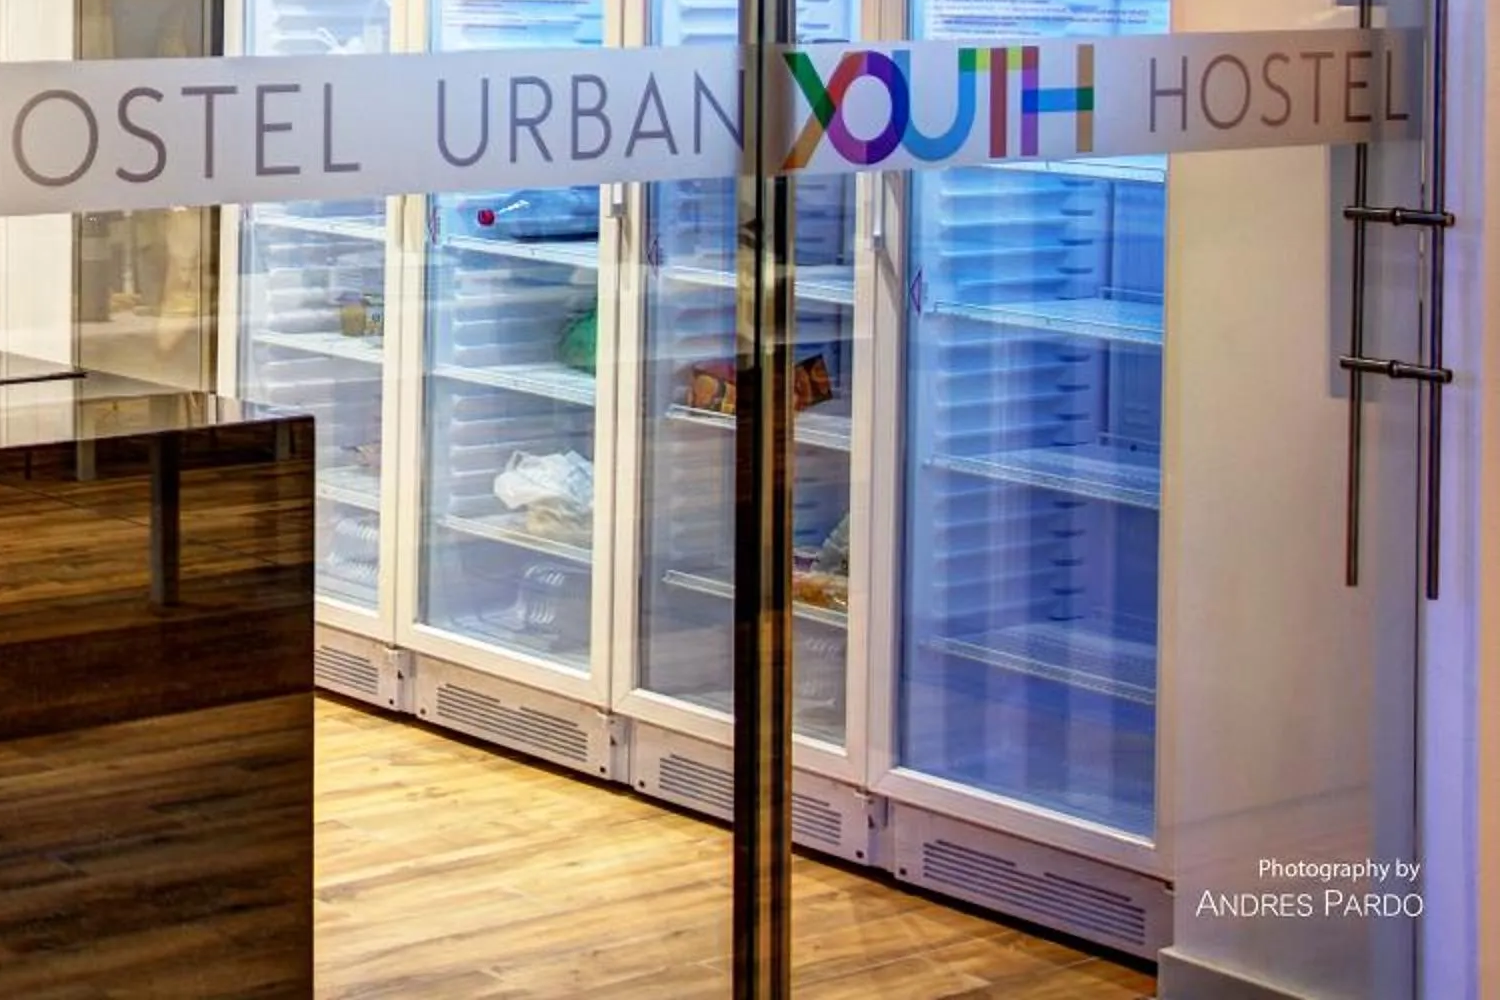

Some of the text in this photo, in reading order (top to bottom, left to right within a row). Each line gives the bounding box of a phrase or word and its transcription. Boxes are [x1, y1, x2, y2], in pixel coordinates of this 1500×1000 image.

[437, 44, 1410, 171] URBAN YOUTH HOSTEL
